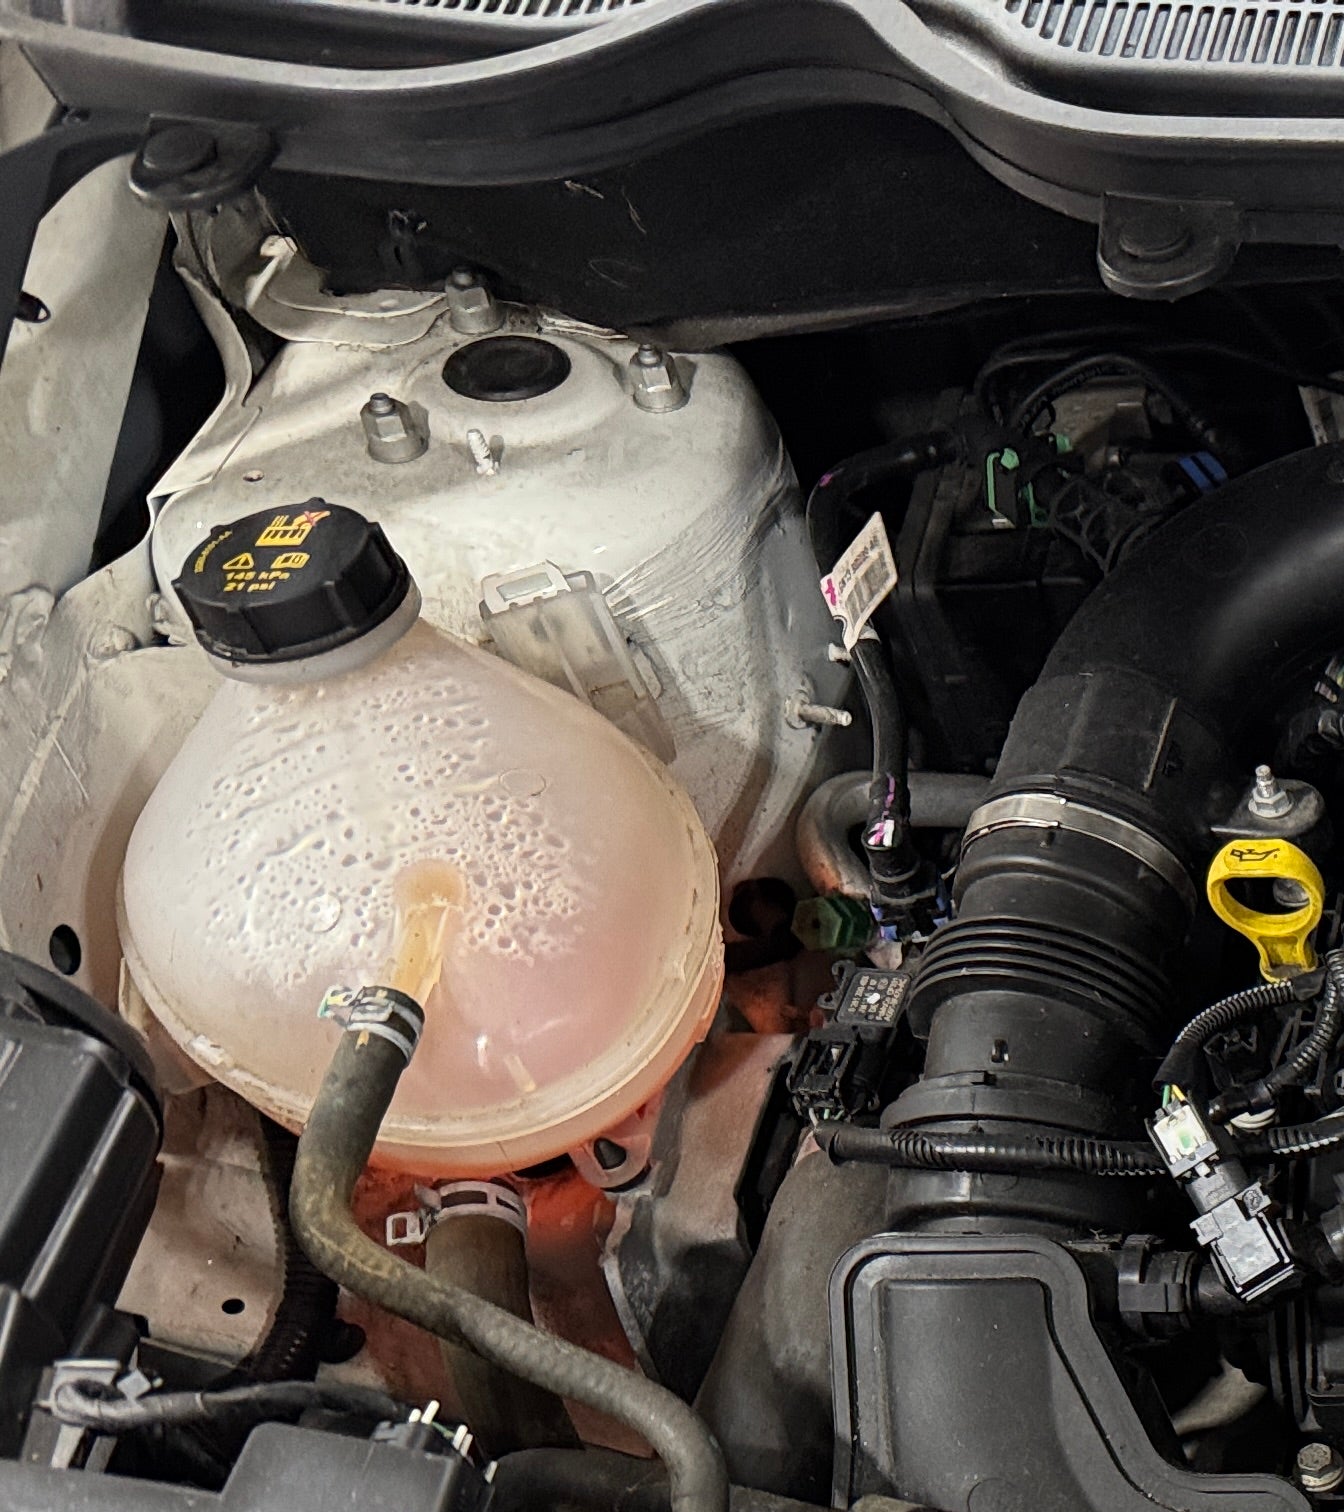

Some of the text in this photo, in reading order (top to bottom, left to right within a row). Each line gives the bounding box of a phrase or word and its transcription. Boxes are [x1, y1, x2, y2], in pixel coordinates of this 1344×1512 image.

[258, 571, 290, 579] kPa
[223, 581, 276, 592] 21 psi
